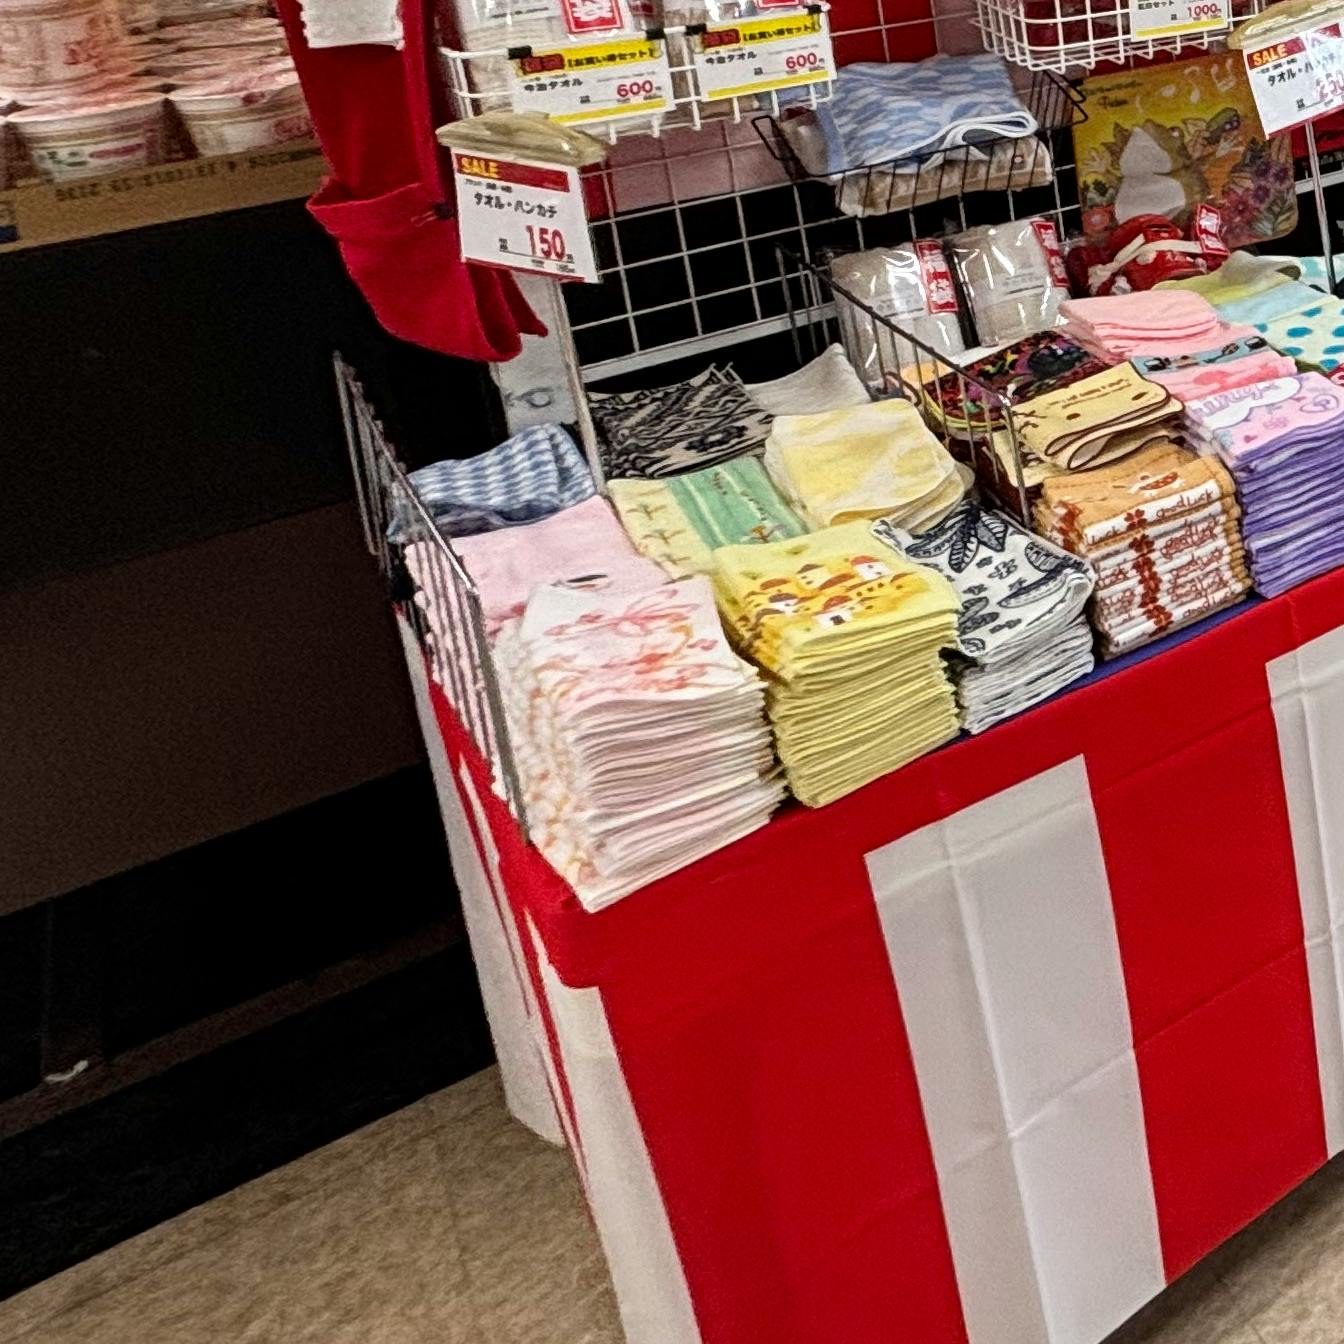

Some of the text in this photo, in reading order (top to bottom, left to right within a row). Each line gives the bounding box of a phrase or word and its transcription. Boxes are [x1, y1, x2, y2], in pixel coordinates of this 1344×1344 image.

[1252, 44, 1288, 66] SALE
[460, 157, 498, 178] SALE
[474, 192, 558, 219] タオル・ハンカチ
